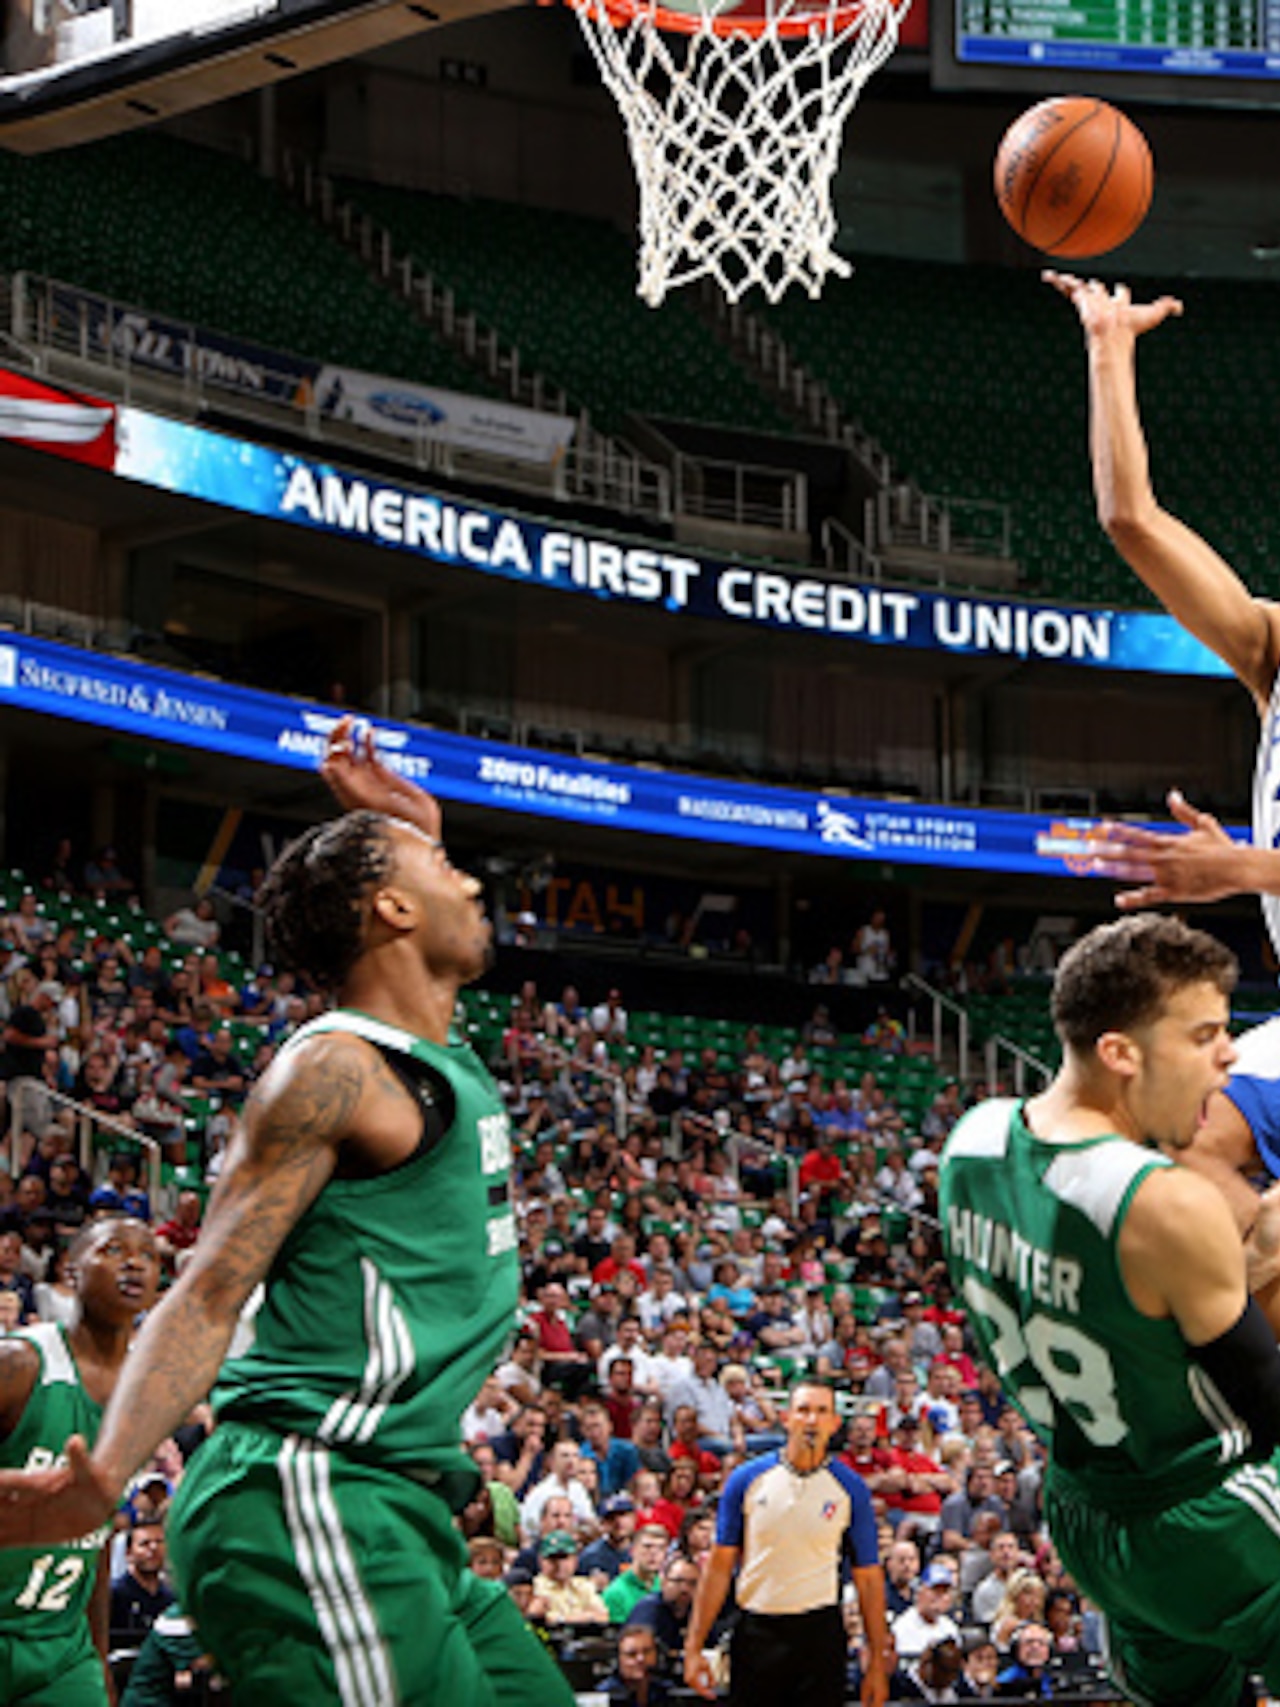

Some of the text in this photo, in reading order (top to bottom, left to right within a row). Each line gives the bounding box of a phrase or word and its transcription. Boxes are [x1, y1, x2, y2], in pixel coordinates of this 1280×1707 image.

[280, 464, 1111, 660] AMERICA FIRST CREDIT UNION
[947, 1205, 1082, 1315] HUNTER
[15, 1553, 85, 1612] 12
